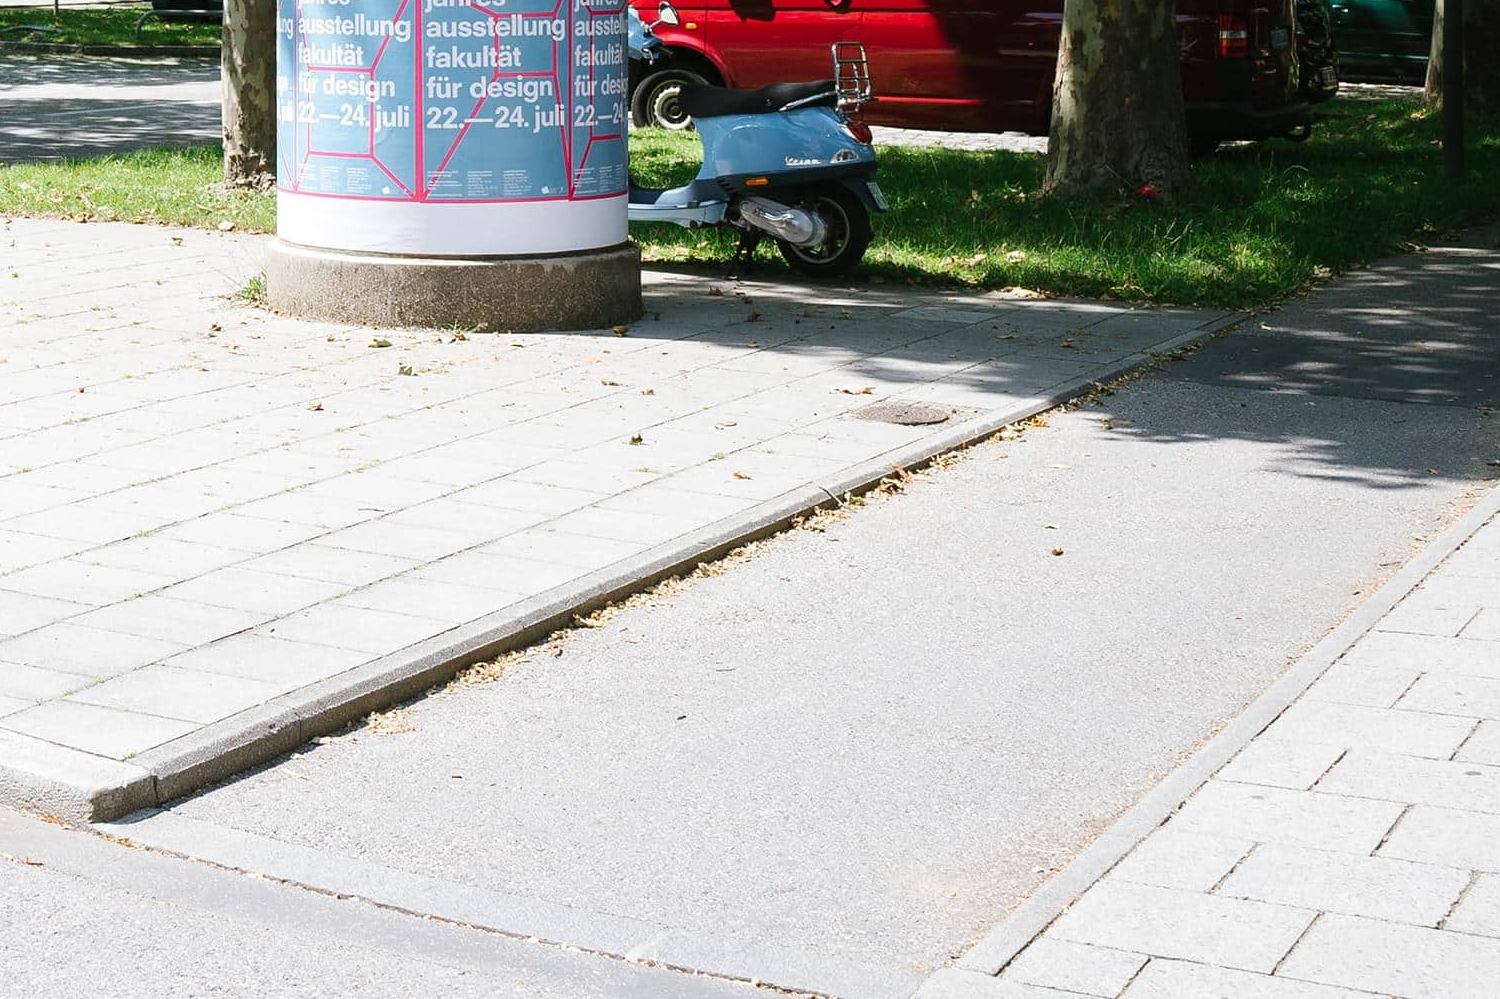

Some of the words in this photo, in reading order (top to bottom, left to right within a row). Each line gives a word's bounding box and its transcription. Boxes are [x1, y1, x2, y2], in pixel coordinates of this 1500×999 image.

[298, 14, 411, 42] ausstellung
[426, 14, 566, 41] ausstellung
[299, 42, 363, 66] fakultät
[426, 45, 522, 68] fakultät
[323, 74, 396, 102] design
[426, 76, 463, 99] für
[469, 75, 553, 104] design
[574, 75, 598, 97] für
[374, 104, 410, 133] juli
[533, 104, 565, 133] juli
